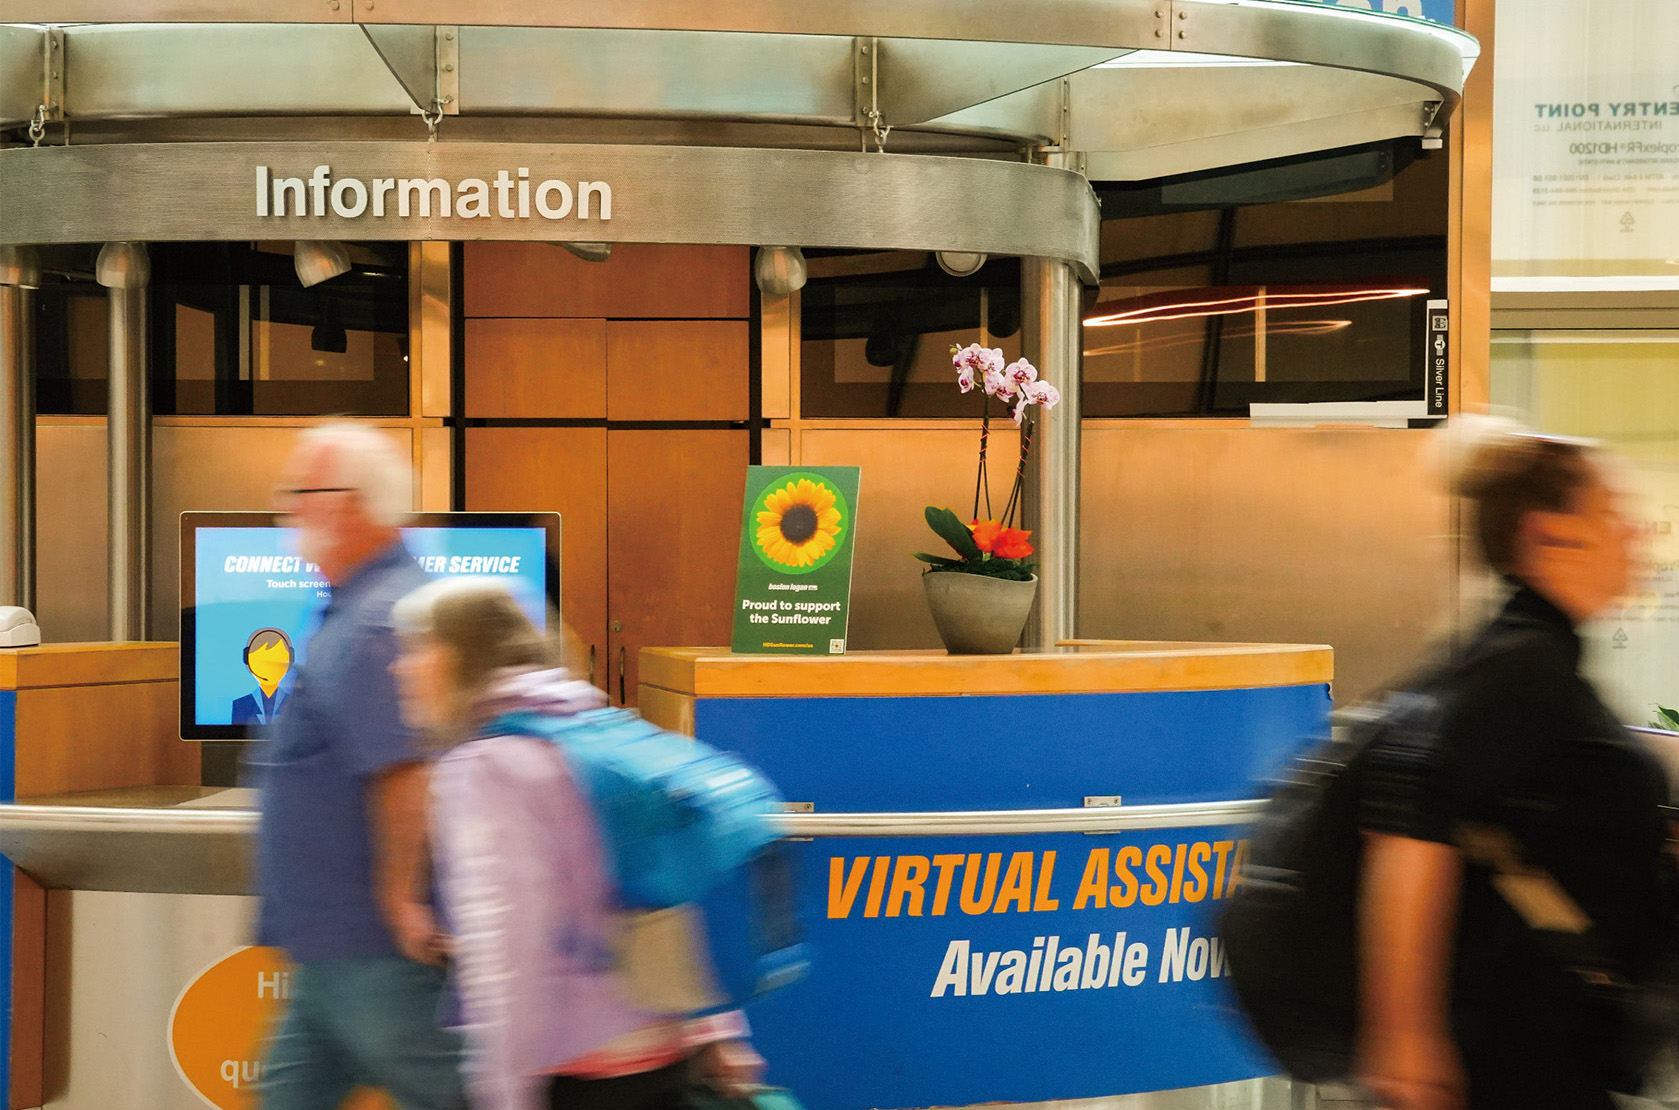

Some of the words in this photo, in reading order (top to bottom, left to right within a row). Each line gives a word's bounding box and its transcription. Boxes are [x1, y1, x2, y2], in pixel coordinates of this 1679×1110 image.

[255, 165, 612, 221] Information
[1435, 358, 1445, 385] Silver
[1435, 388, 1444, 408] Line
[223, 555, 303, 573] CONNECT
[448, 555, 521, 573] SERVICE
[266, 579, 296, 588] Touch
[299, 580, 331, 588] screen
[742, 599, 777, 611] Proud
[780, 601, 792, 611] to
[795, 600, 841, 613] support
[750, 613, 769, 624] the
[771, 613, 831, 625] Sunflower
[827, 850, 1060, 919] VIRTUAL
[930, 931, 1149, 998] Available
[257, 971, 289, 999] Hi
